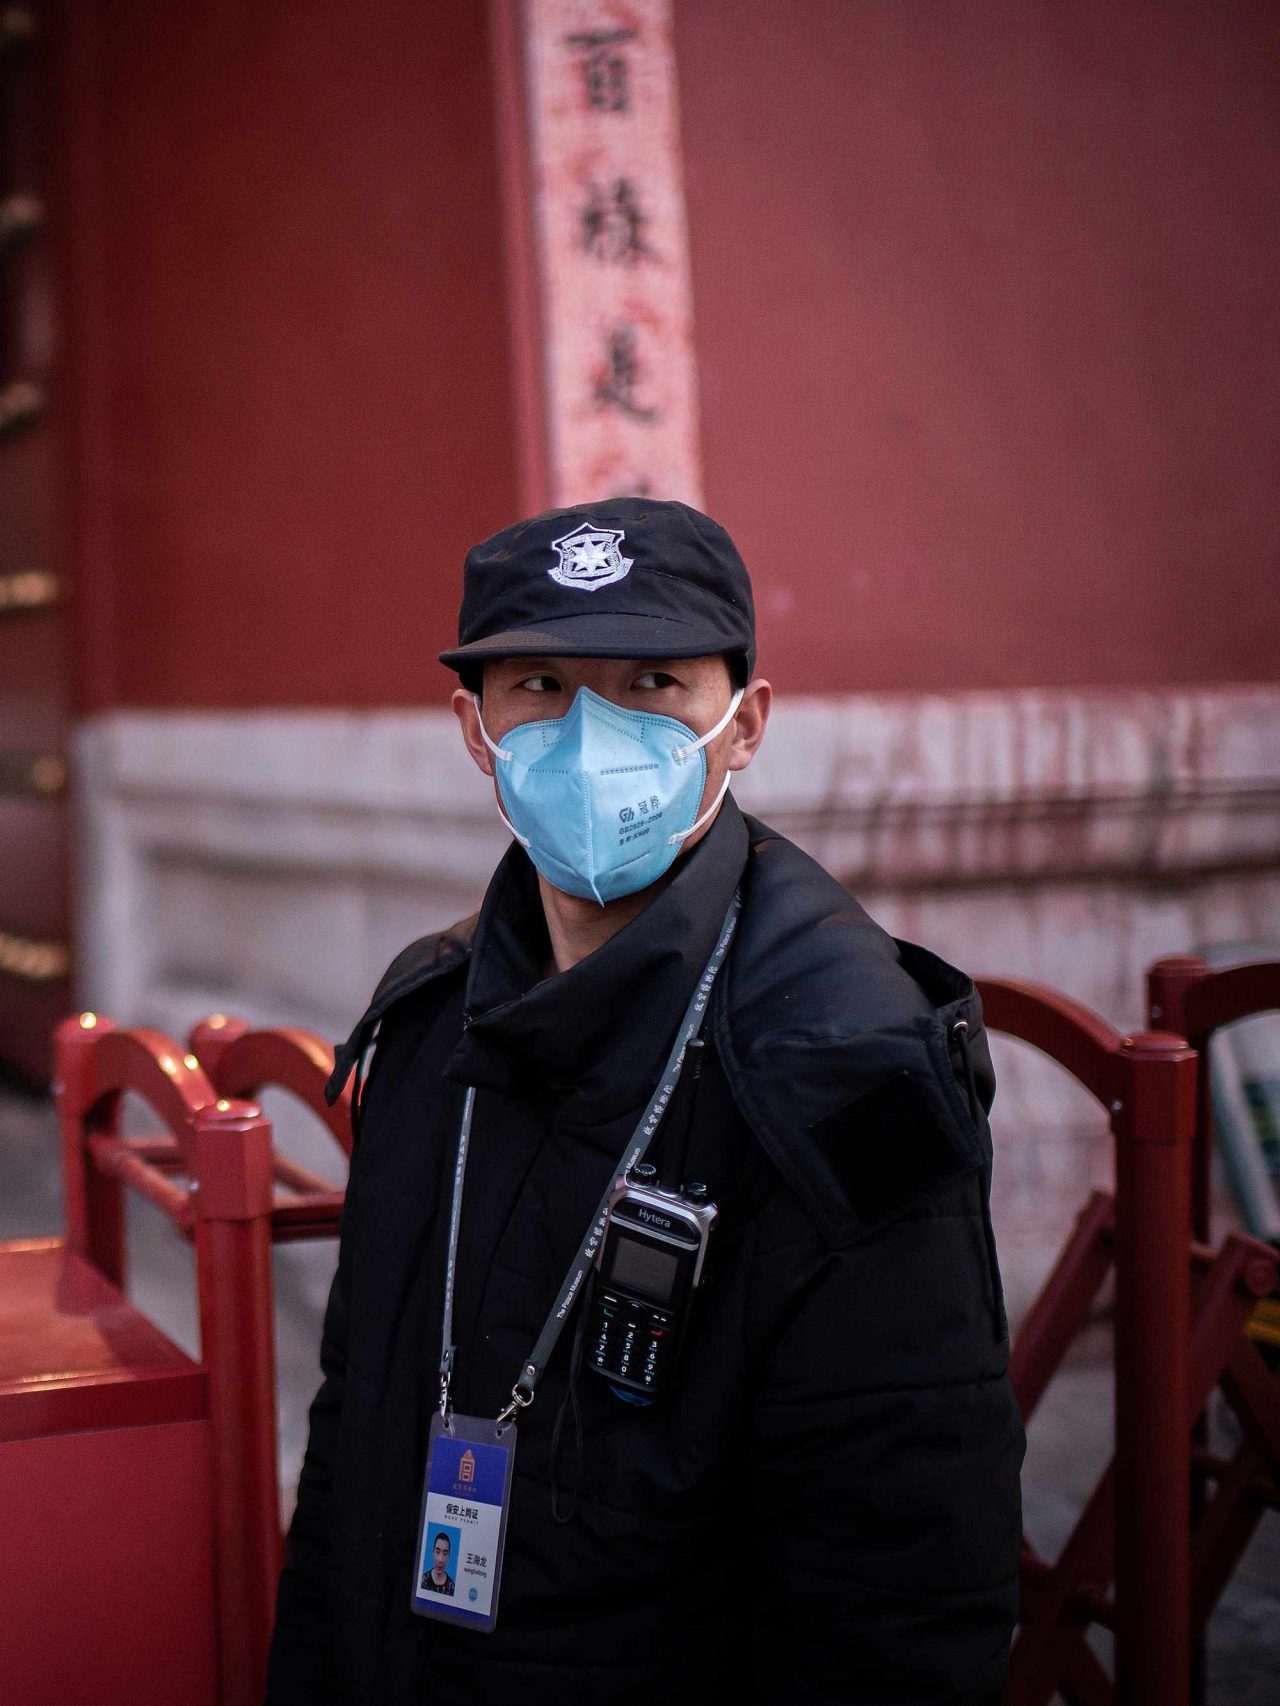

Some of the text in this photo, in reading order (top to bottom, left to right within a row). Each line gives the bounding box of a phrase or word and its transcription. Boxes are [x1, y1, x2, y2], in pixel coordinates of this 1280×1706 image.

[638, 1208, 671, 1229] Hytera
[446, 1503, 479, 1520] 保安上岗证
[465, 1553, 487, 1568] 王海龙
